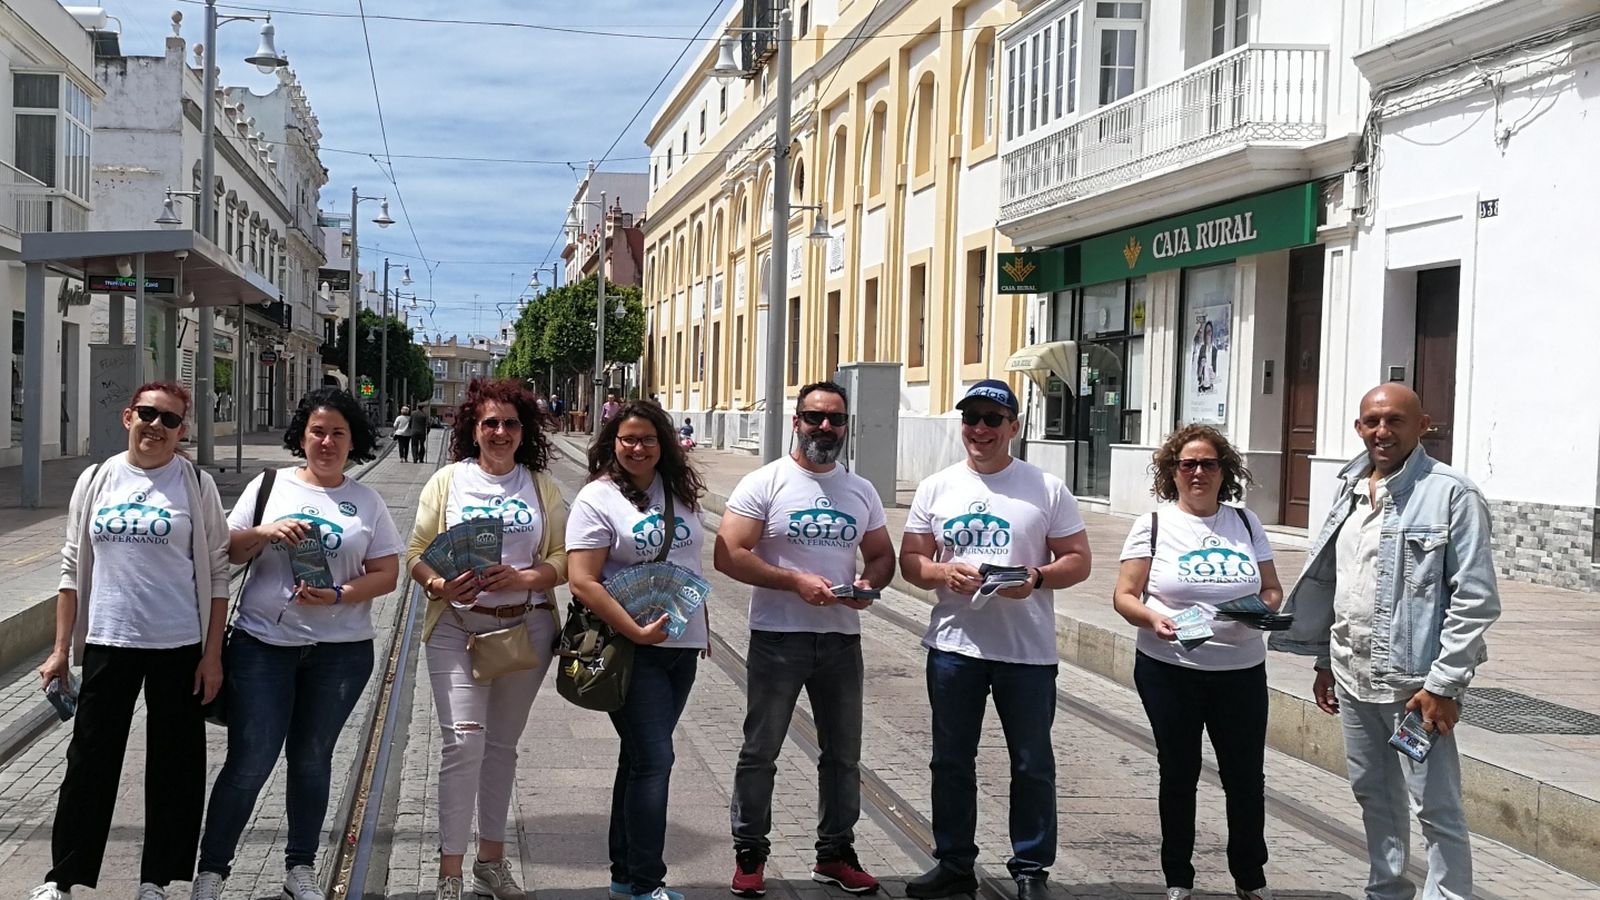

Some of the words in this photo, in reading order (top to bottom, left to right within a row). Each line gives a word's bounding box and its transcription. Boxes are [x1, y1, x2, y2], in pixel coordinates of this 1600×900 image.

[1152, 227, 1191, 259] CAJA
[1195, 211, 1257, 251] RURAL
[94, 517, 171, 536] SOLO
[787, 521, 857, 541] SOLO
[95, 534, 110, 543] SAN
[112, 535, 169, 545] FERNANDO
[634, 524, 691, 550] SOO
[807, 539, 853, 548] FERNANDO
[943, 529, 1010, 547] SOLO
[1178, 562, 1256, 576] SOLO
